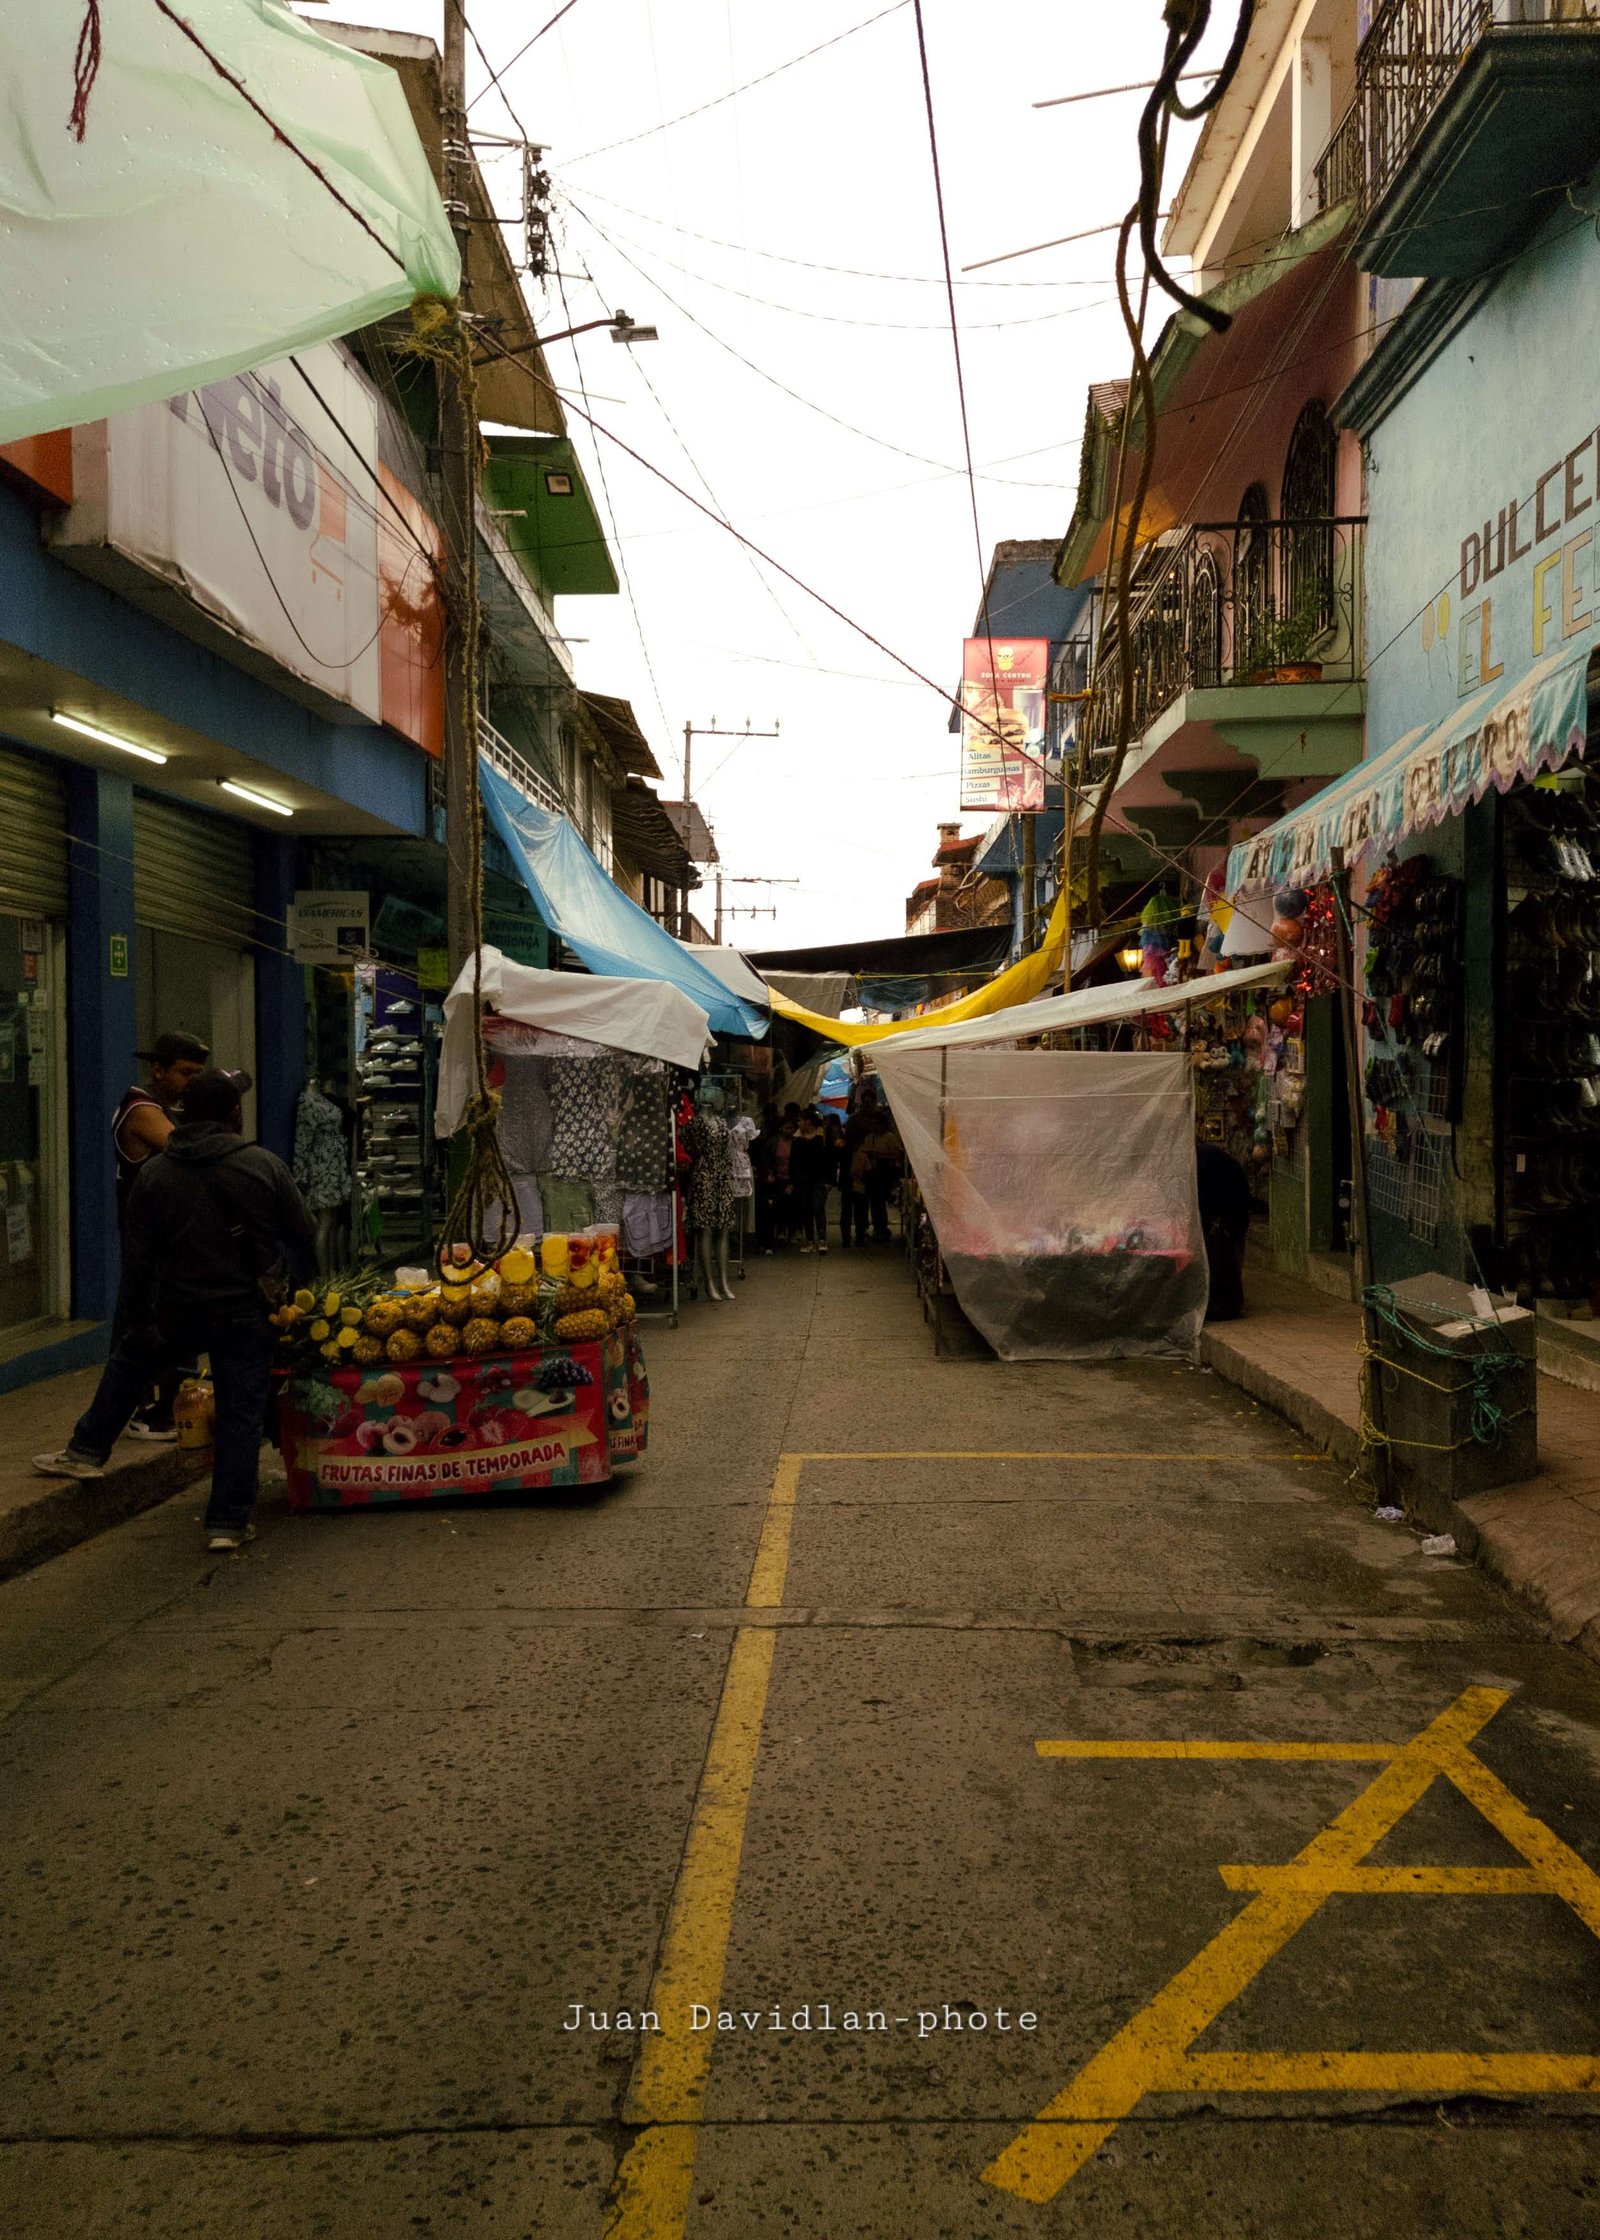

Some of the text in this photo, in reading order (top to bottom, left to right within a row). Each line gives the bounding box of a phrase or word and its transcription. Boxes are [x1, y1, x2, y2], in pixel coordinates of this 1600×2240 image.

[1460, 427, 1600, 601] DULCE
[1457, 519, 1600, 699] EL FE
[968, 752, 992, 760] Alitas
[965, 794, 988, 803] Sushi
[321, 1441, 566, 1483] FRUTAS FINAS DE TEMPORADA
